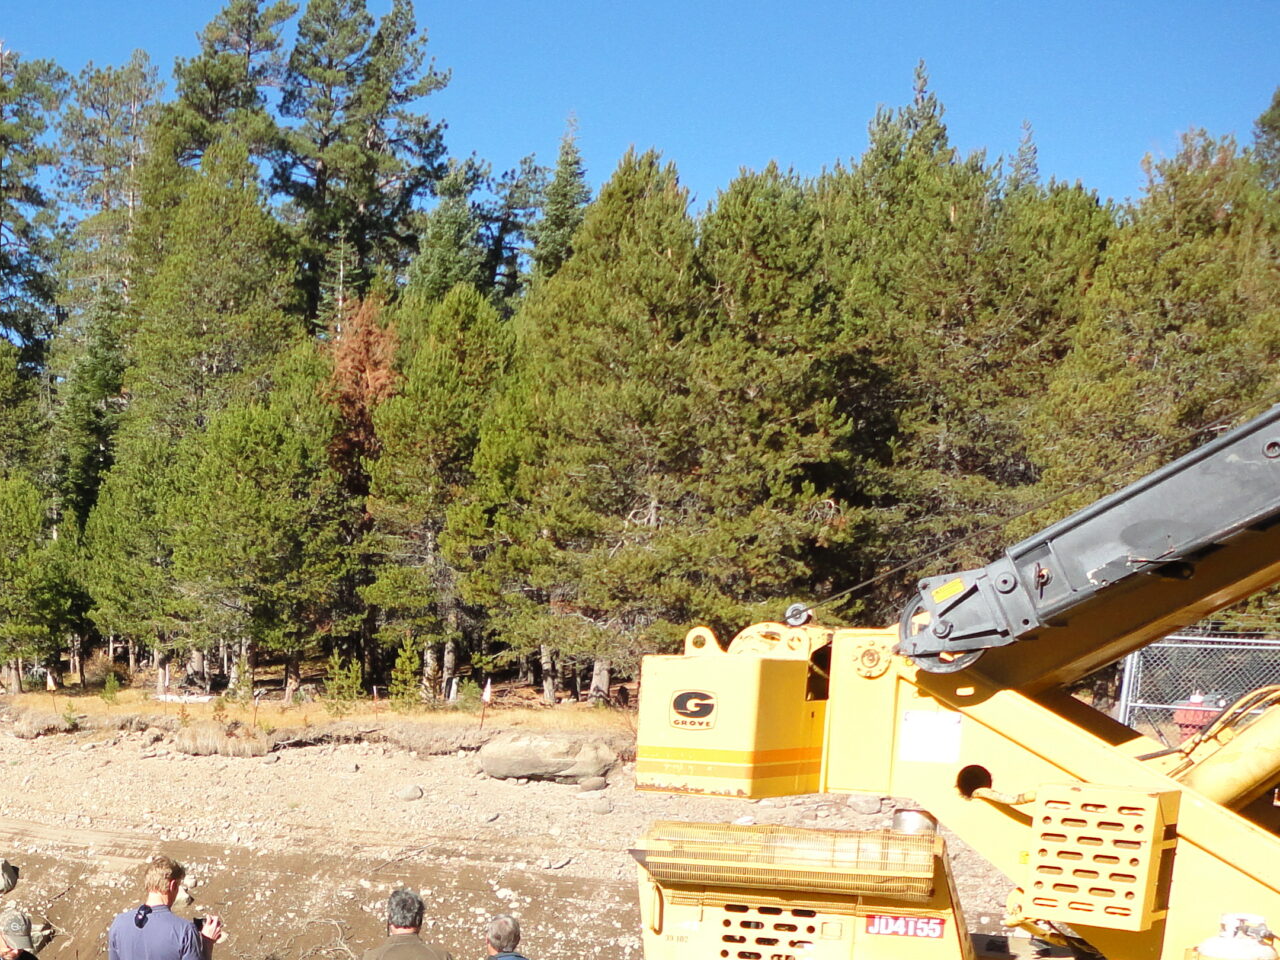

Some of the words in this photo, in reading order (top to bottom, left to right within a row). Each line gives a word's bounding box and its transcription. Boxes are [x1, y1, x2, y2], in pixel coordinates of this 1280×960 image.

[673, 692, 714, 718] G
[673, 719, 711, 727] GROVE
[867, 915, 941, 938] JD4T55
